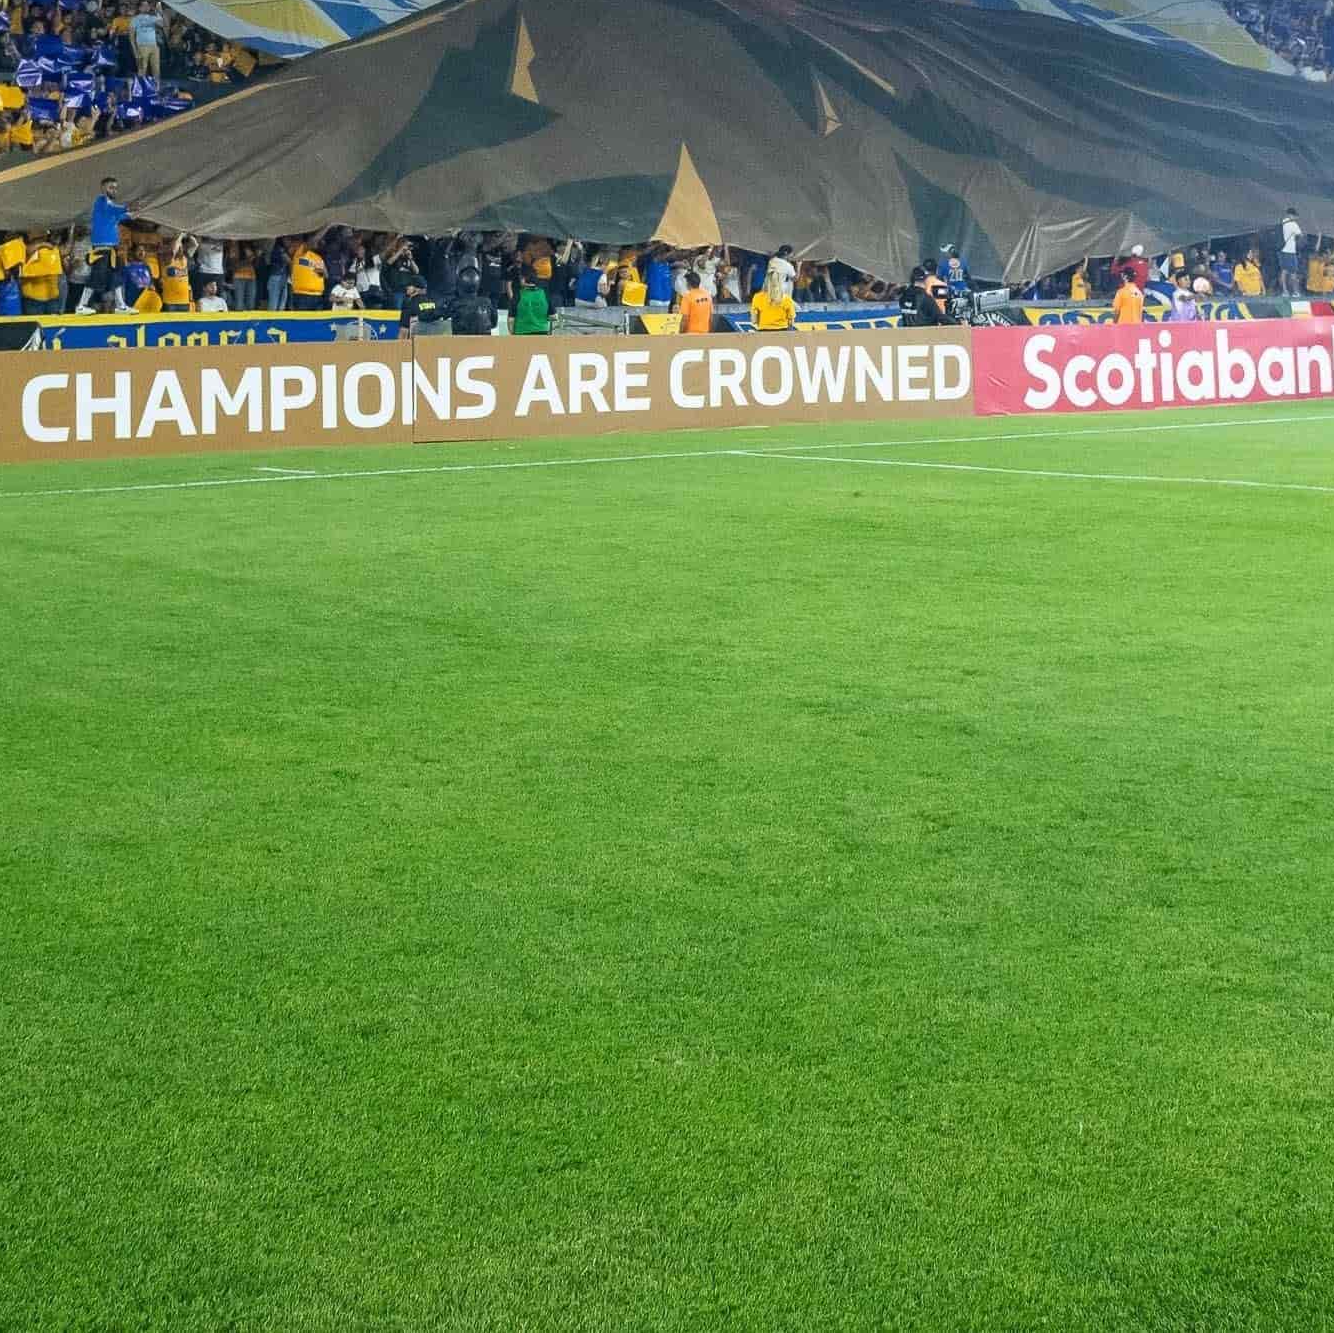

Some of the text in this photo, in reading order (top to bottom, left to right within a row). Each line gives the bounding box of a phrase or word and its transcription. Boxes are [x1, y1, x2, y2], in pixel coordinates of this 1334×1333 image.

[21, 354, 495, 442] CHAMPIONS
[514, 350, 651, 417] ARE
[669, 342, 970, 409] CROWNED
